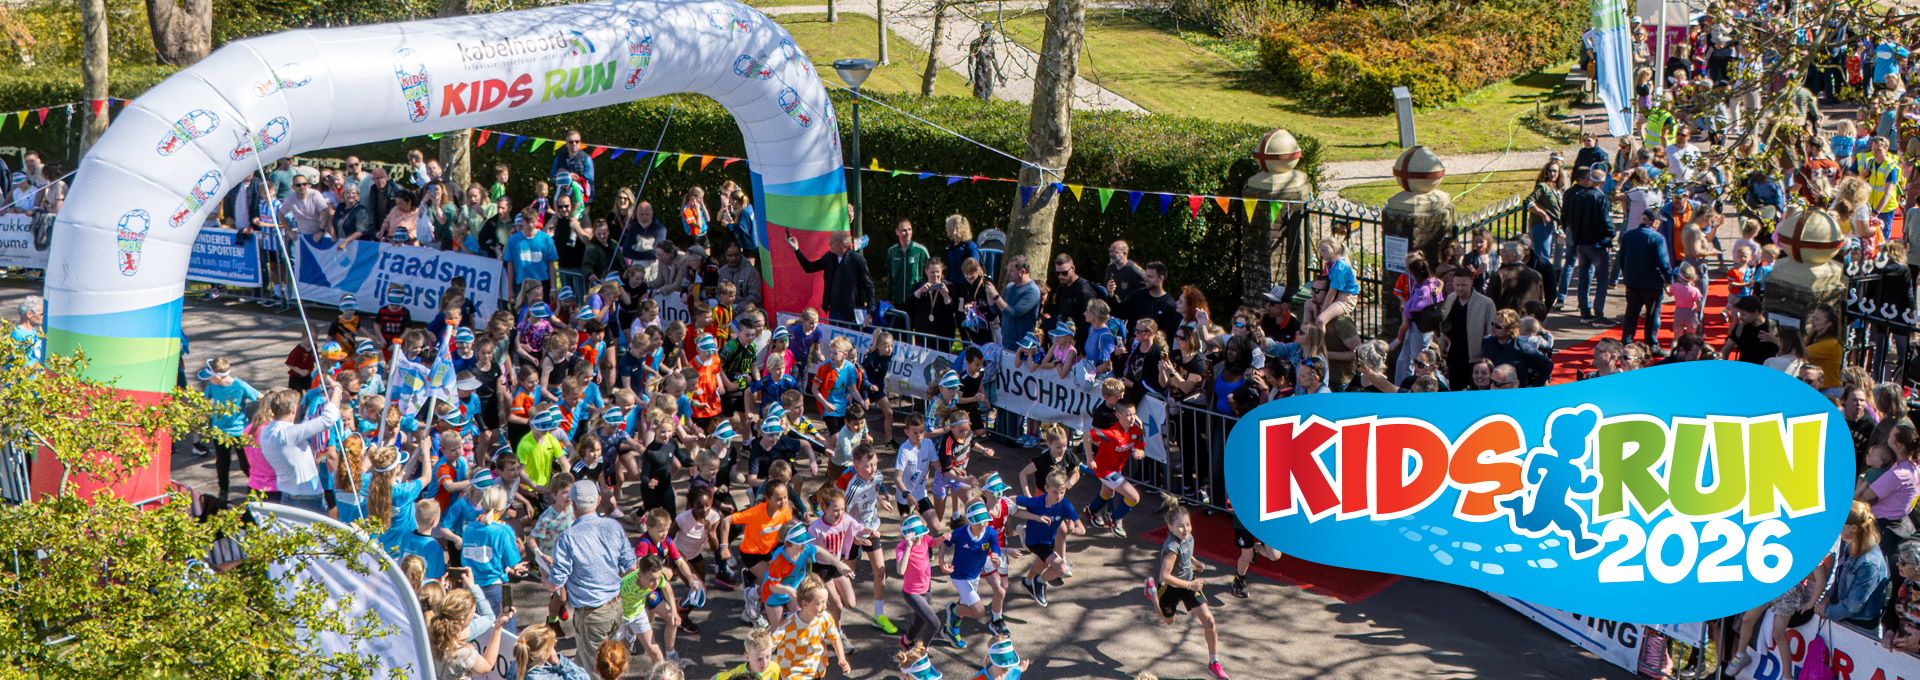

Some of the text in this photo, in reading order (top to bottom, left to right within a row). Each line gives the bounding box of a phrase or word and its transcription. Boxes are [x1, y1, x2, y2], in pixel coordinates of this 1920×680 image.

[457, 30, 568, 62] kabelnoord
[630, 44, 651, 55] KIDS
[400, 73, 427, 87] KIDS
[404, 84, 428, 99] RUN
[440, 60, 617, 117] KIDS RUN
[119, 229, 144, 241] KIDS
[378, 251, 492, 293] raadsma
